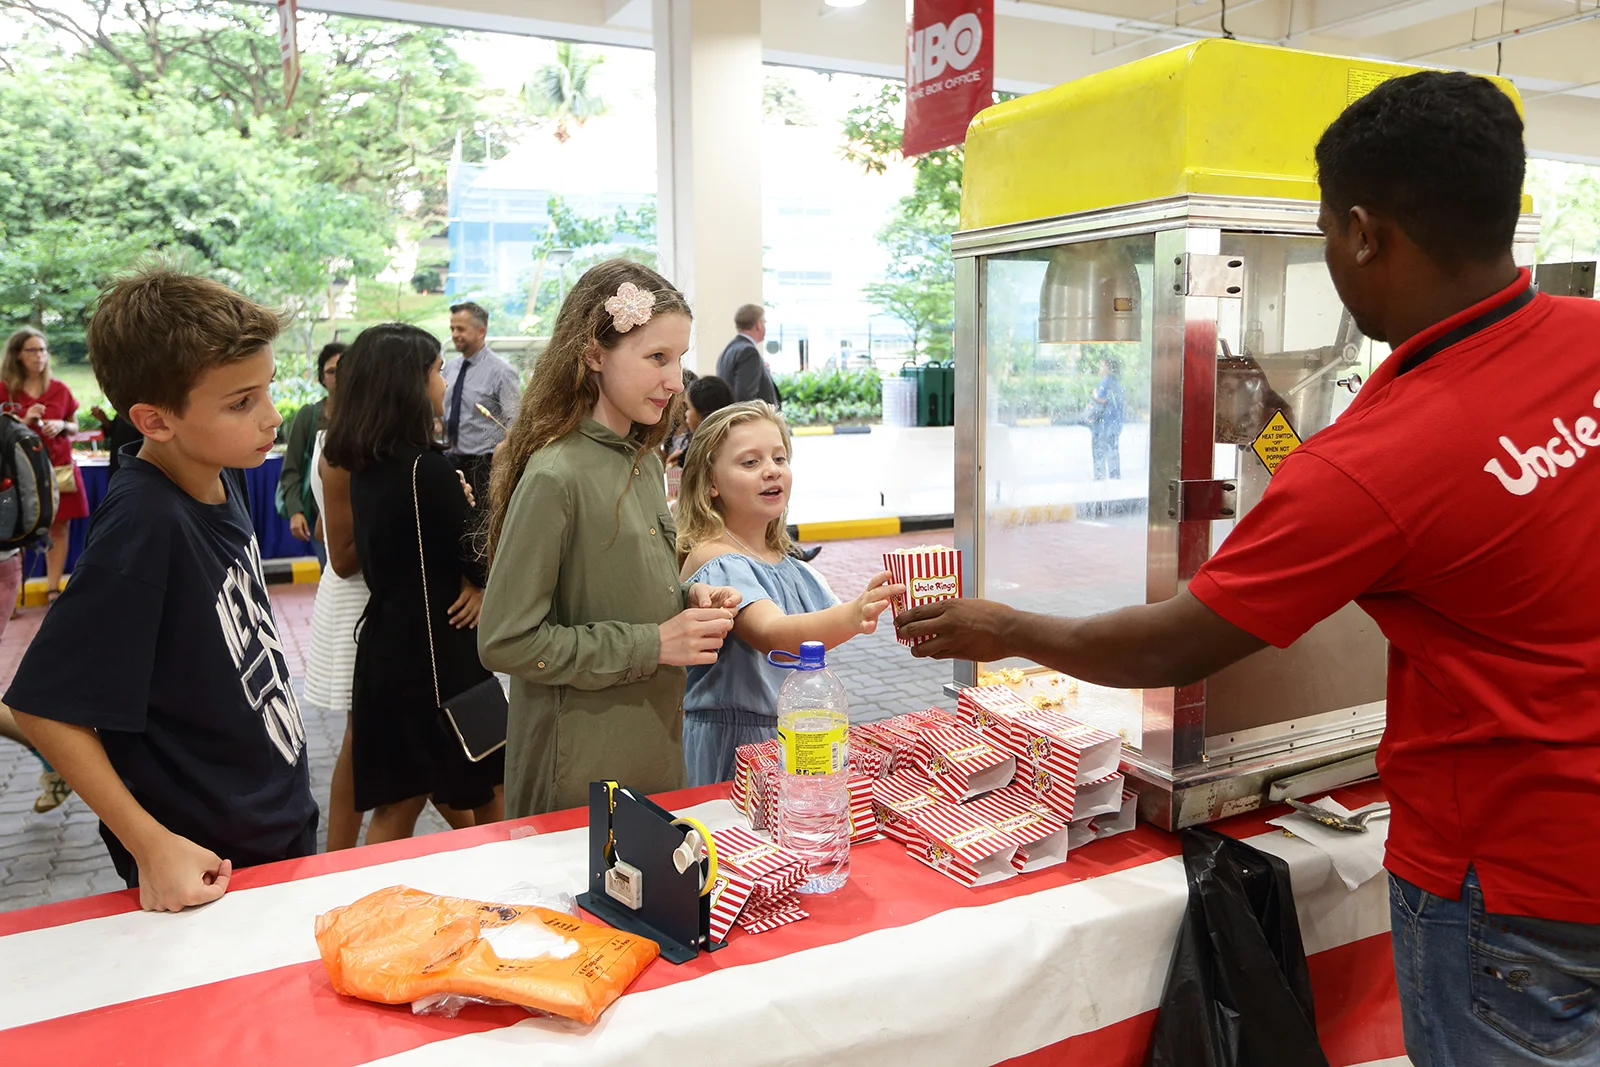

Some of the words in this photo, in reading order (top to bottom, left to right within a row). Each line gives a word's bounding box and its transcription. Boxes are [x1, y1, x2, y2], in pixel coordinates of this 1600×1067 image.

[944, 70, 981, 89] OFFICE
[1483, 415, 1600, 496] Uncle
[914, 582, 934, 592] Uncle
[935, 581, 956, 592] Ringo
